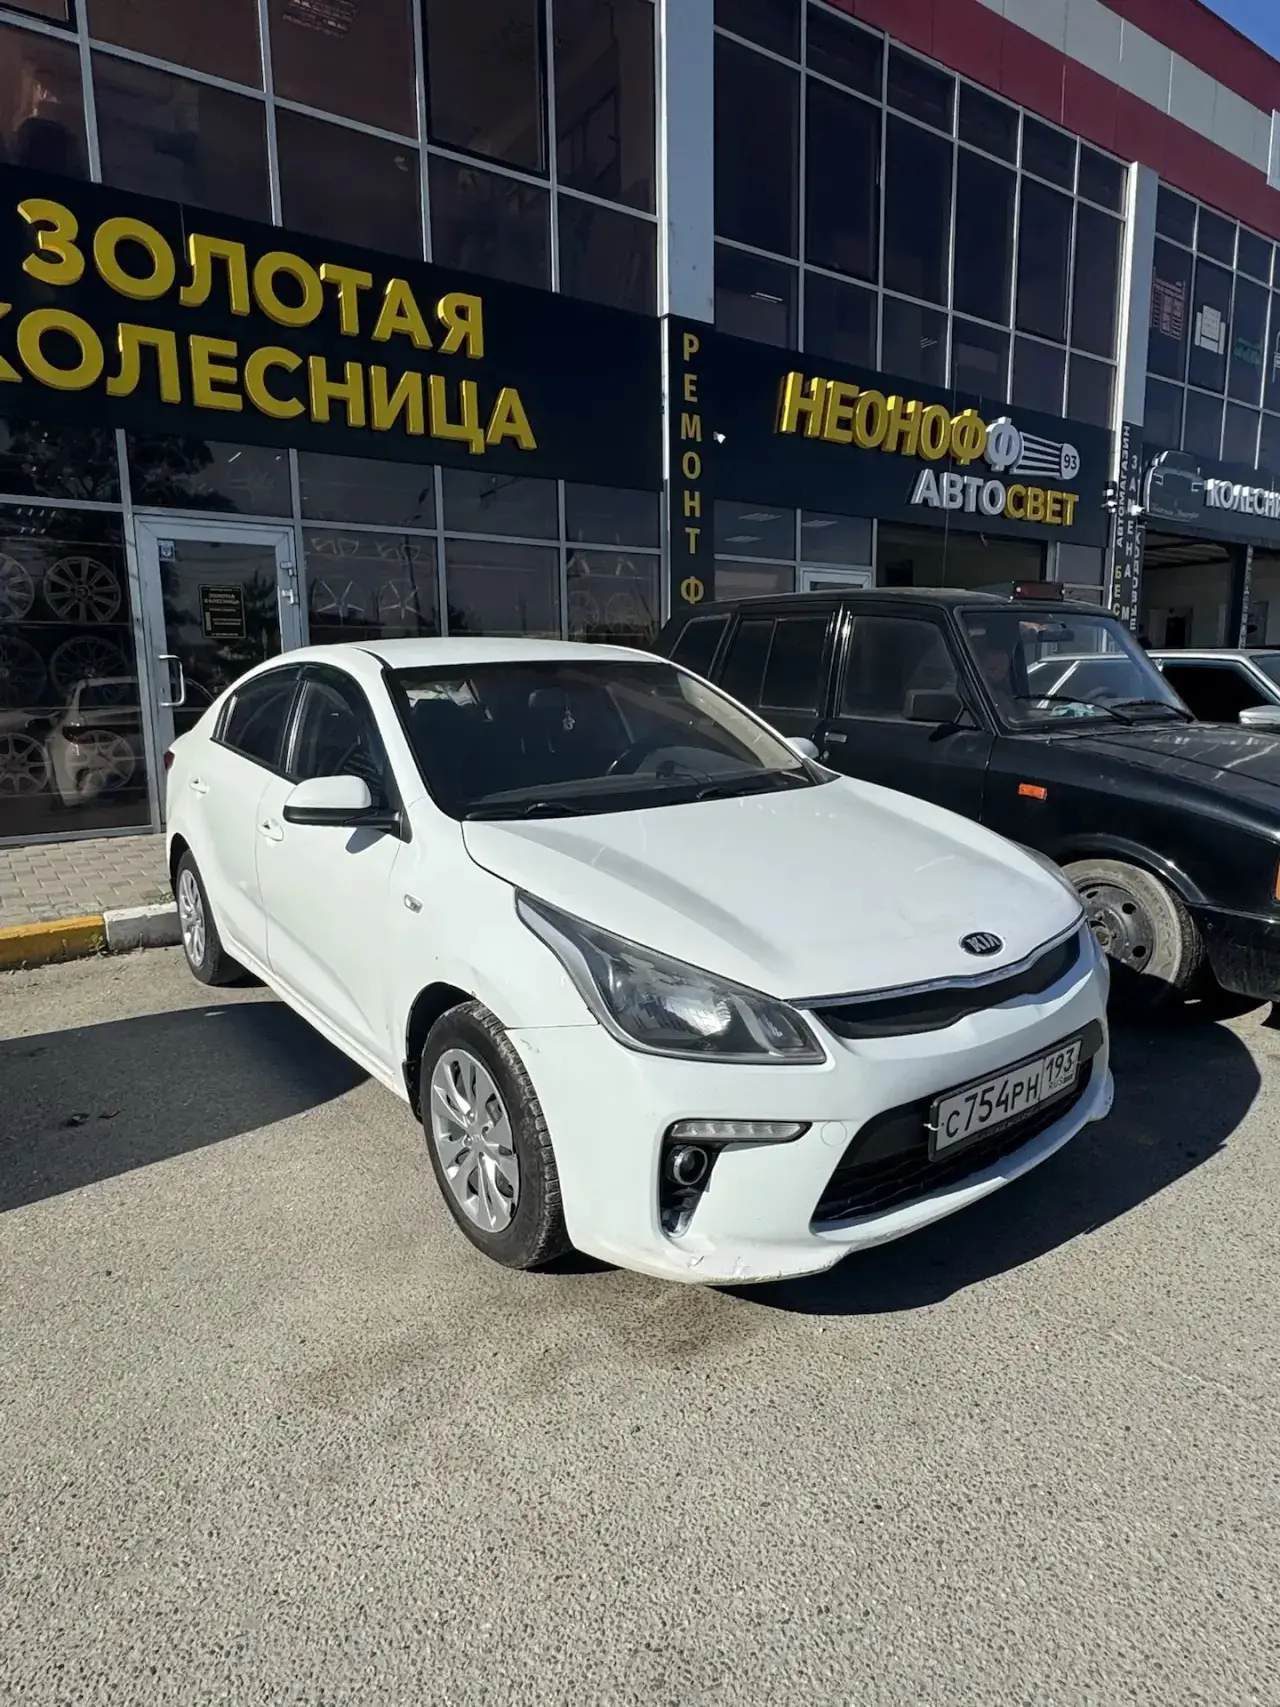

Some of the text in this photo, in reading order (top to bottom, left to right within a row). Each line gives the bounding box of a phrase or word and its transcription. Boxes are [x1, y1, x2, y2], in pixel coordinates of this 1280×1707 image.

[17, 198, 484, 359] ЗОЛОТАЯ
[680, 332, 702, 554] РЕМОНТ
[776, 371, 1021, 472] НЕОНОФФ
[1063, 453, 1078, 470] 93
[910, 468, 1079, 526] АВТОСВЕТ
[1116, 425, 1130, 548] АВТОМАГАЗИН
[966, 933, 1001, 952] KIA
[946, 1074, 1040, 1138] С754РН
[1046, 1048, 1075, 1082] 193
